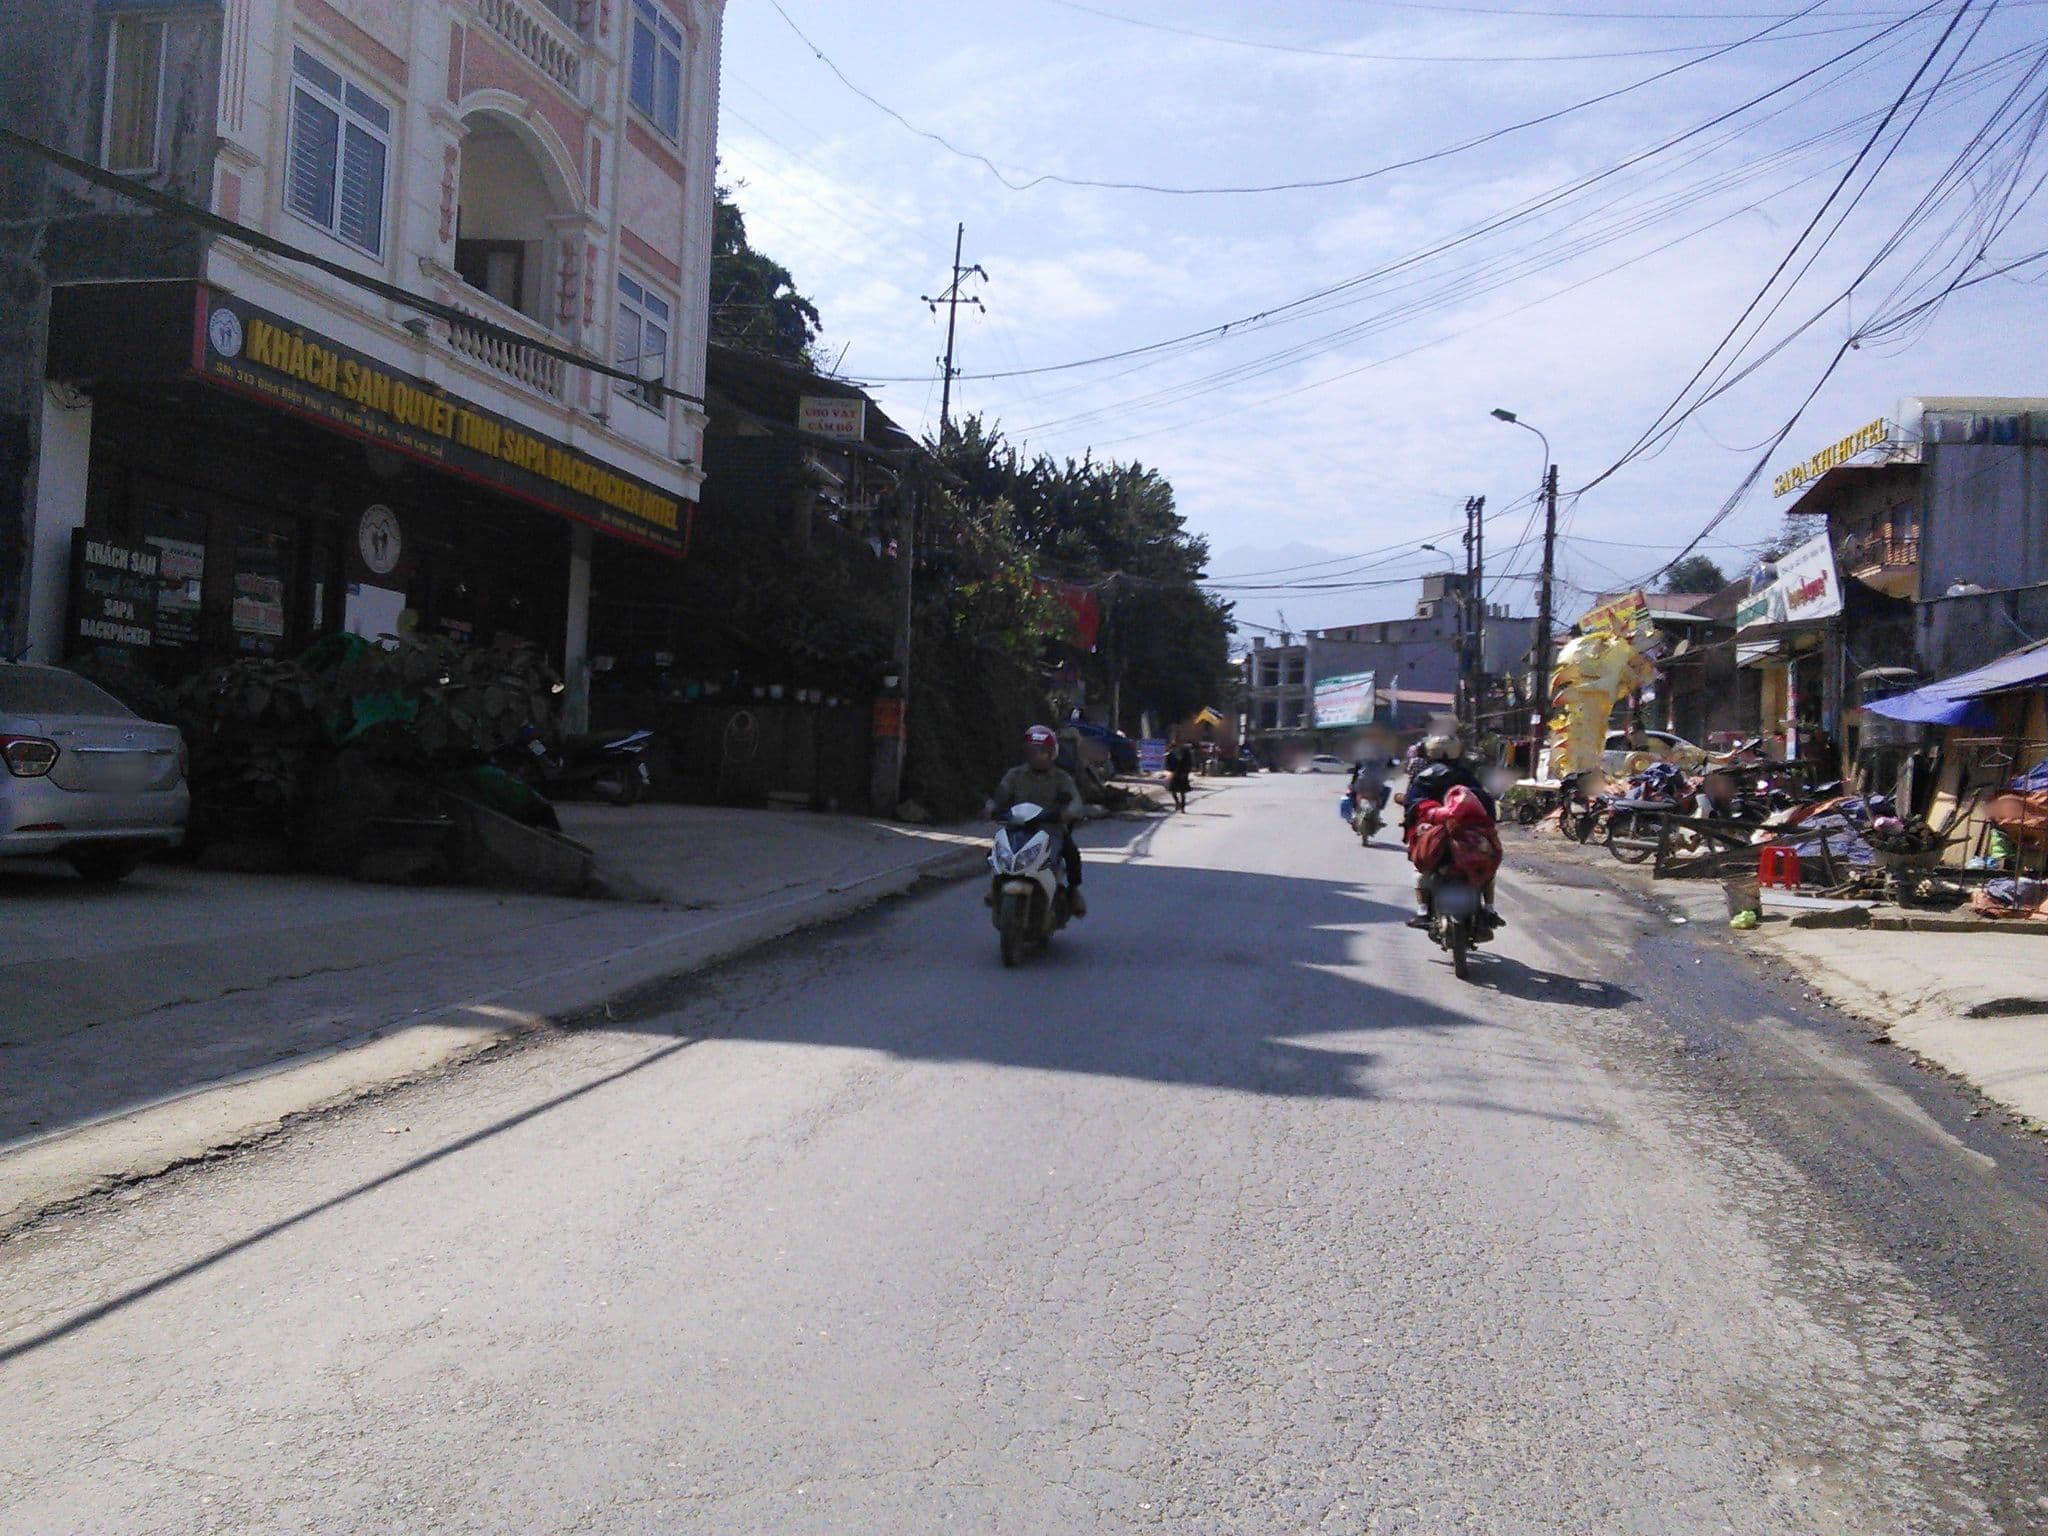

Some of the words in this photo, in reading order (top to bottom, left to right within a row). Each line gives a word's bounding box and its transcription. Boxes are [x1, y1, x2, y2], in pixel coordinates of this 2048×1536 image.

[247, 318, 339, 392] KHÁCH
[503, 429, 547, 477] SAPA
[548, 447, 642, 516] BACKPACKER
[643, 489, 680, 531] HOTEL
[1773, 461, 1808, 498] SAPA
[1837, 417, 1888, 466] HOTEL
